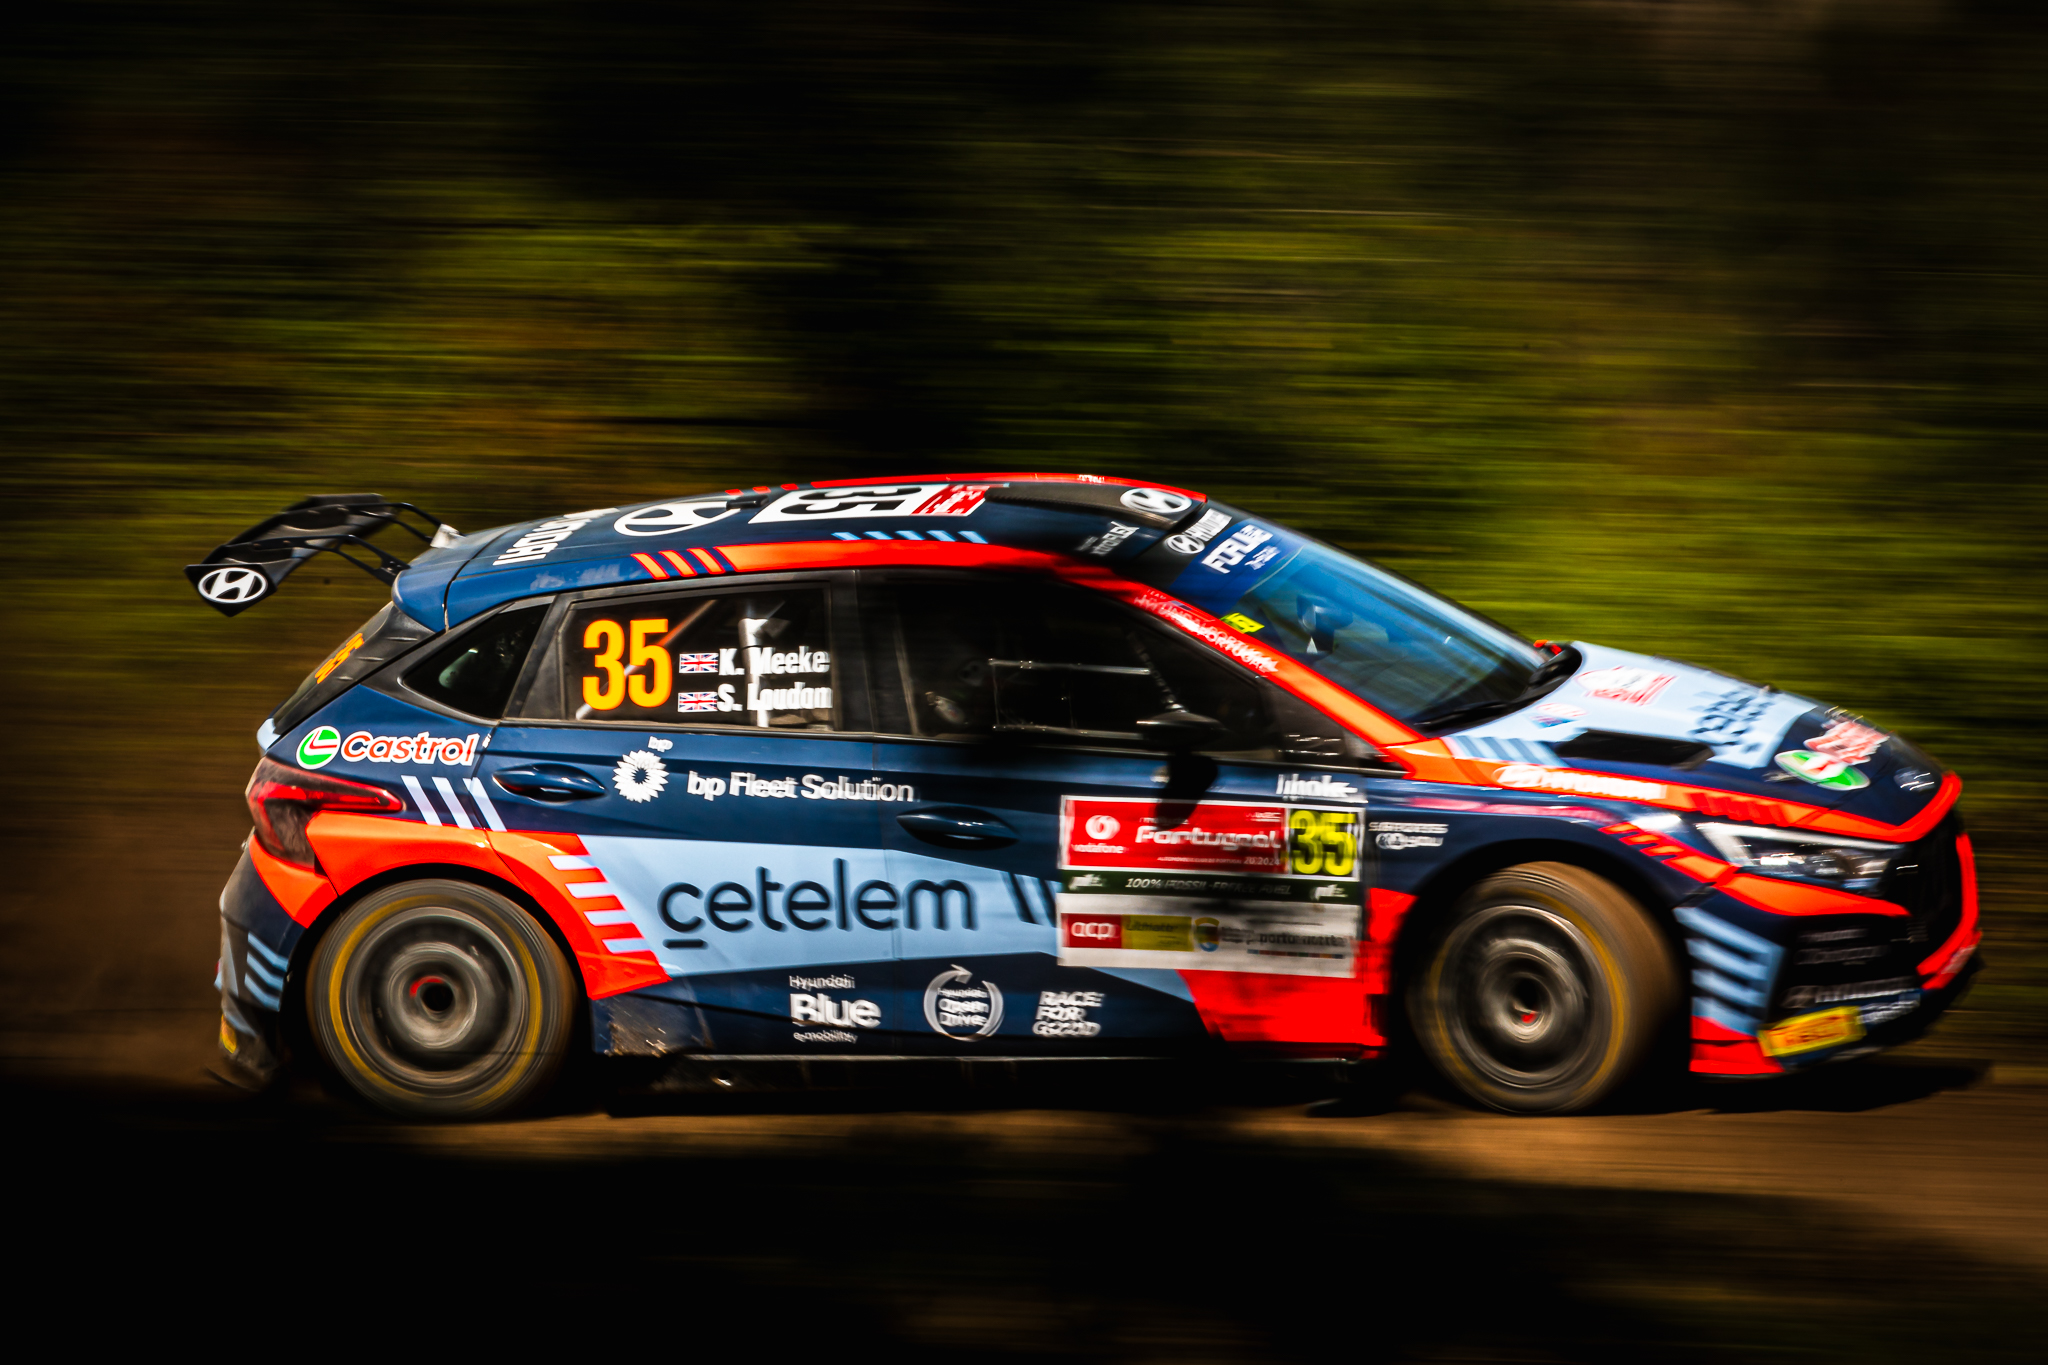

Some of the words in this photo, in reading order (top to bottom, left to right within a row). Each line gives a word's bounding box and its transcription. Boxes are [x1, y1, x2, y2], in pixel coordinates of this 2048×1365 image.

[582, 618, 672, 710] 35
[719, 647, 745, 676] K.
[750, 645, 830, 675] Meeke
[716, 683, 744, 712] S.
[342, 732, 478, 764] Castrol
[687, 771, 726, 801] bp
[729, 772, 799, 799] Fleet
[1072, 843, 1127, 854] vodafone
[1135, 827, 1281, 850] Portugal
[1290, 810, 1357, 876] 35
[1125, 878, 1161, 889] 100%
[657, 858, 978, 942] cetelem
[789, 974, 856, 991] Hyundai
[790, 993, 882, 1029] Blue
[1039, 991, 1105, 1007] RACE
